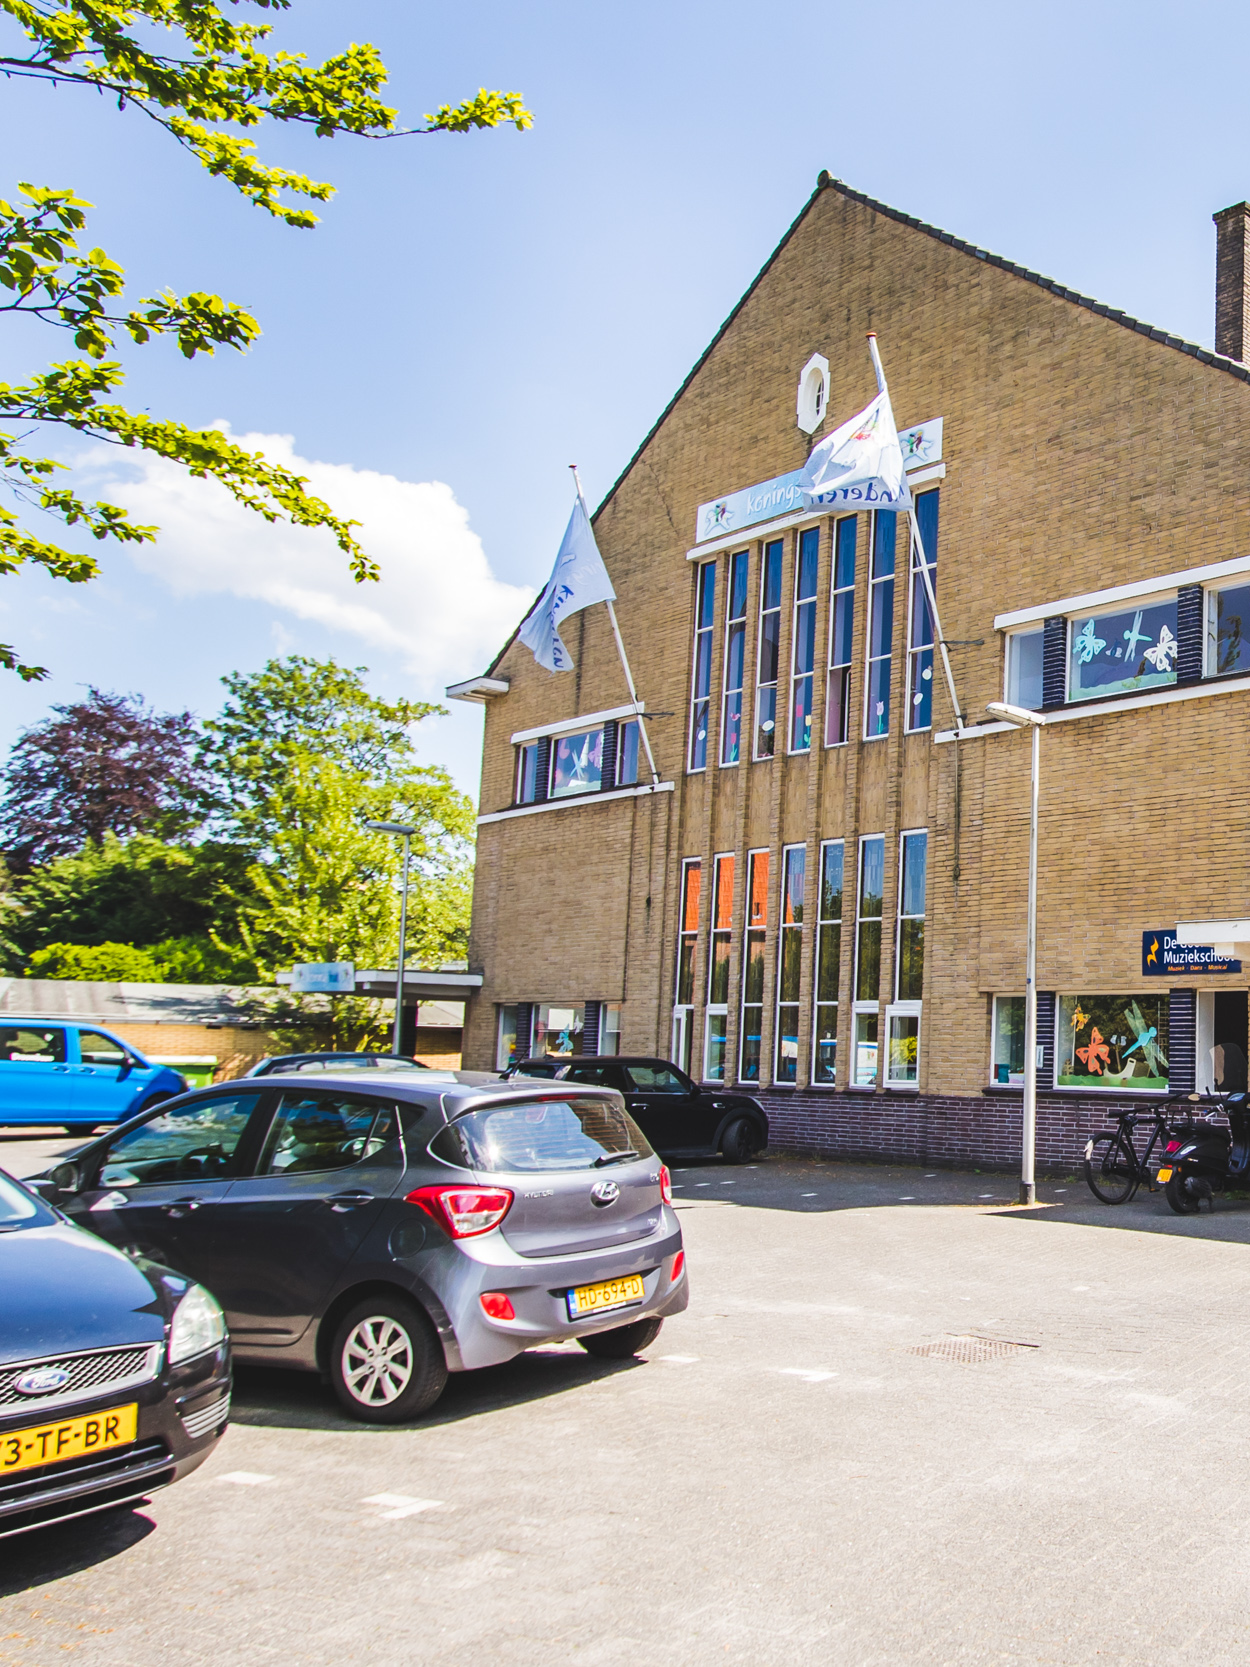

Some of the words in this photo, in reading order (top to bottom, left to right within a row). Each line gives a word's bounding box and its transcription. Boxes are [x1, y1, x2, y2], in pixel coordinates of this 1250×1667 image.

[1163, 936, 1177, 949] De
[1163, 948, 1235, 964] Muziekscho
[578, 1278, 640, 1308] HD-694-D
[0, 1416, 120, 1466] 3-TF-BR
